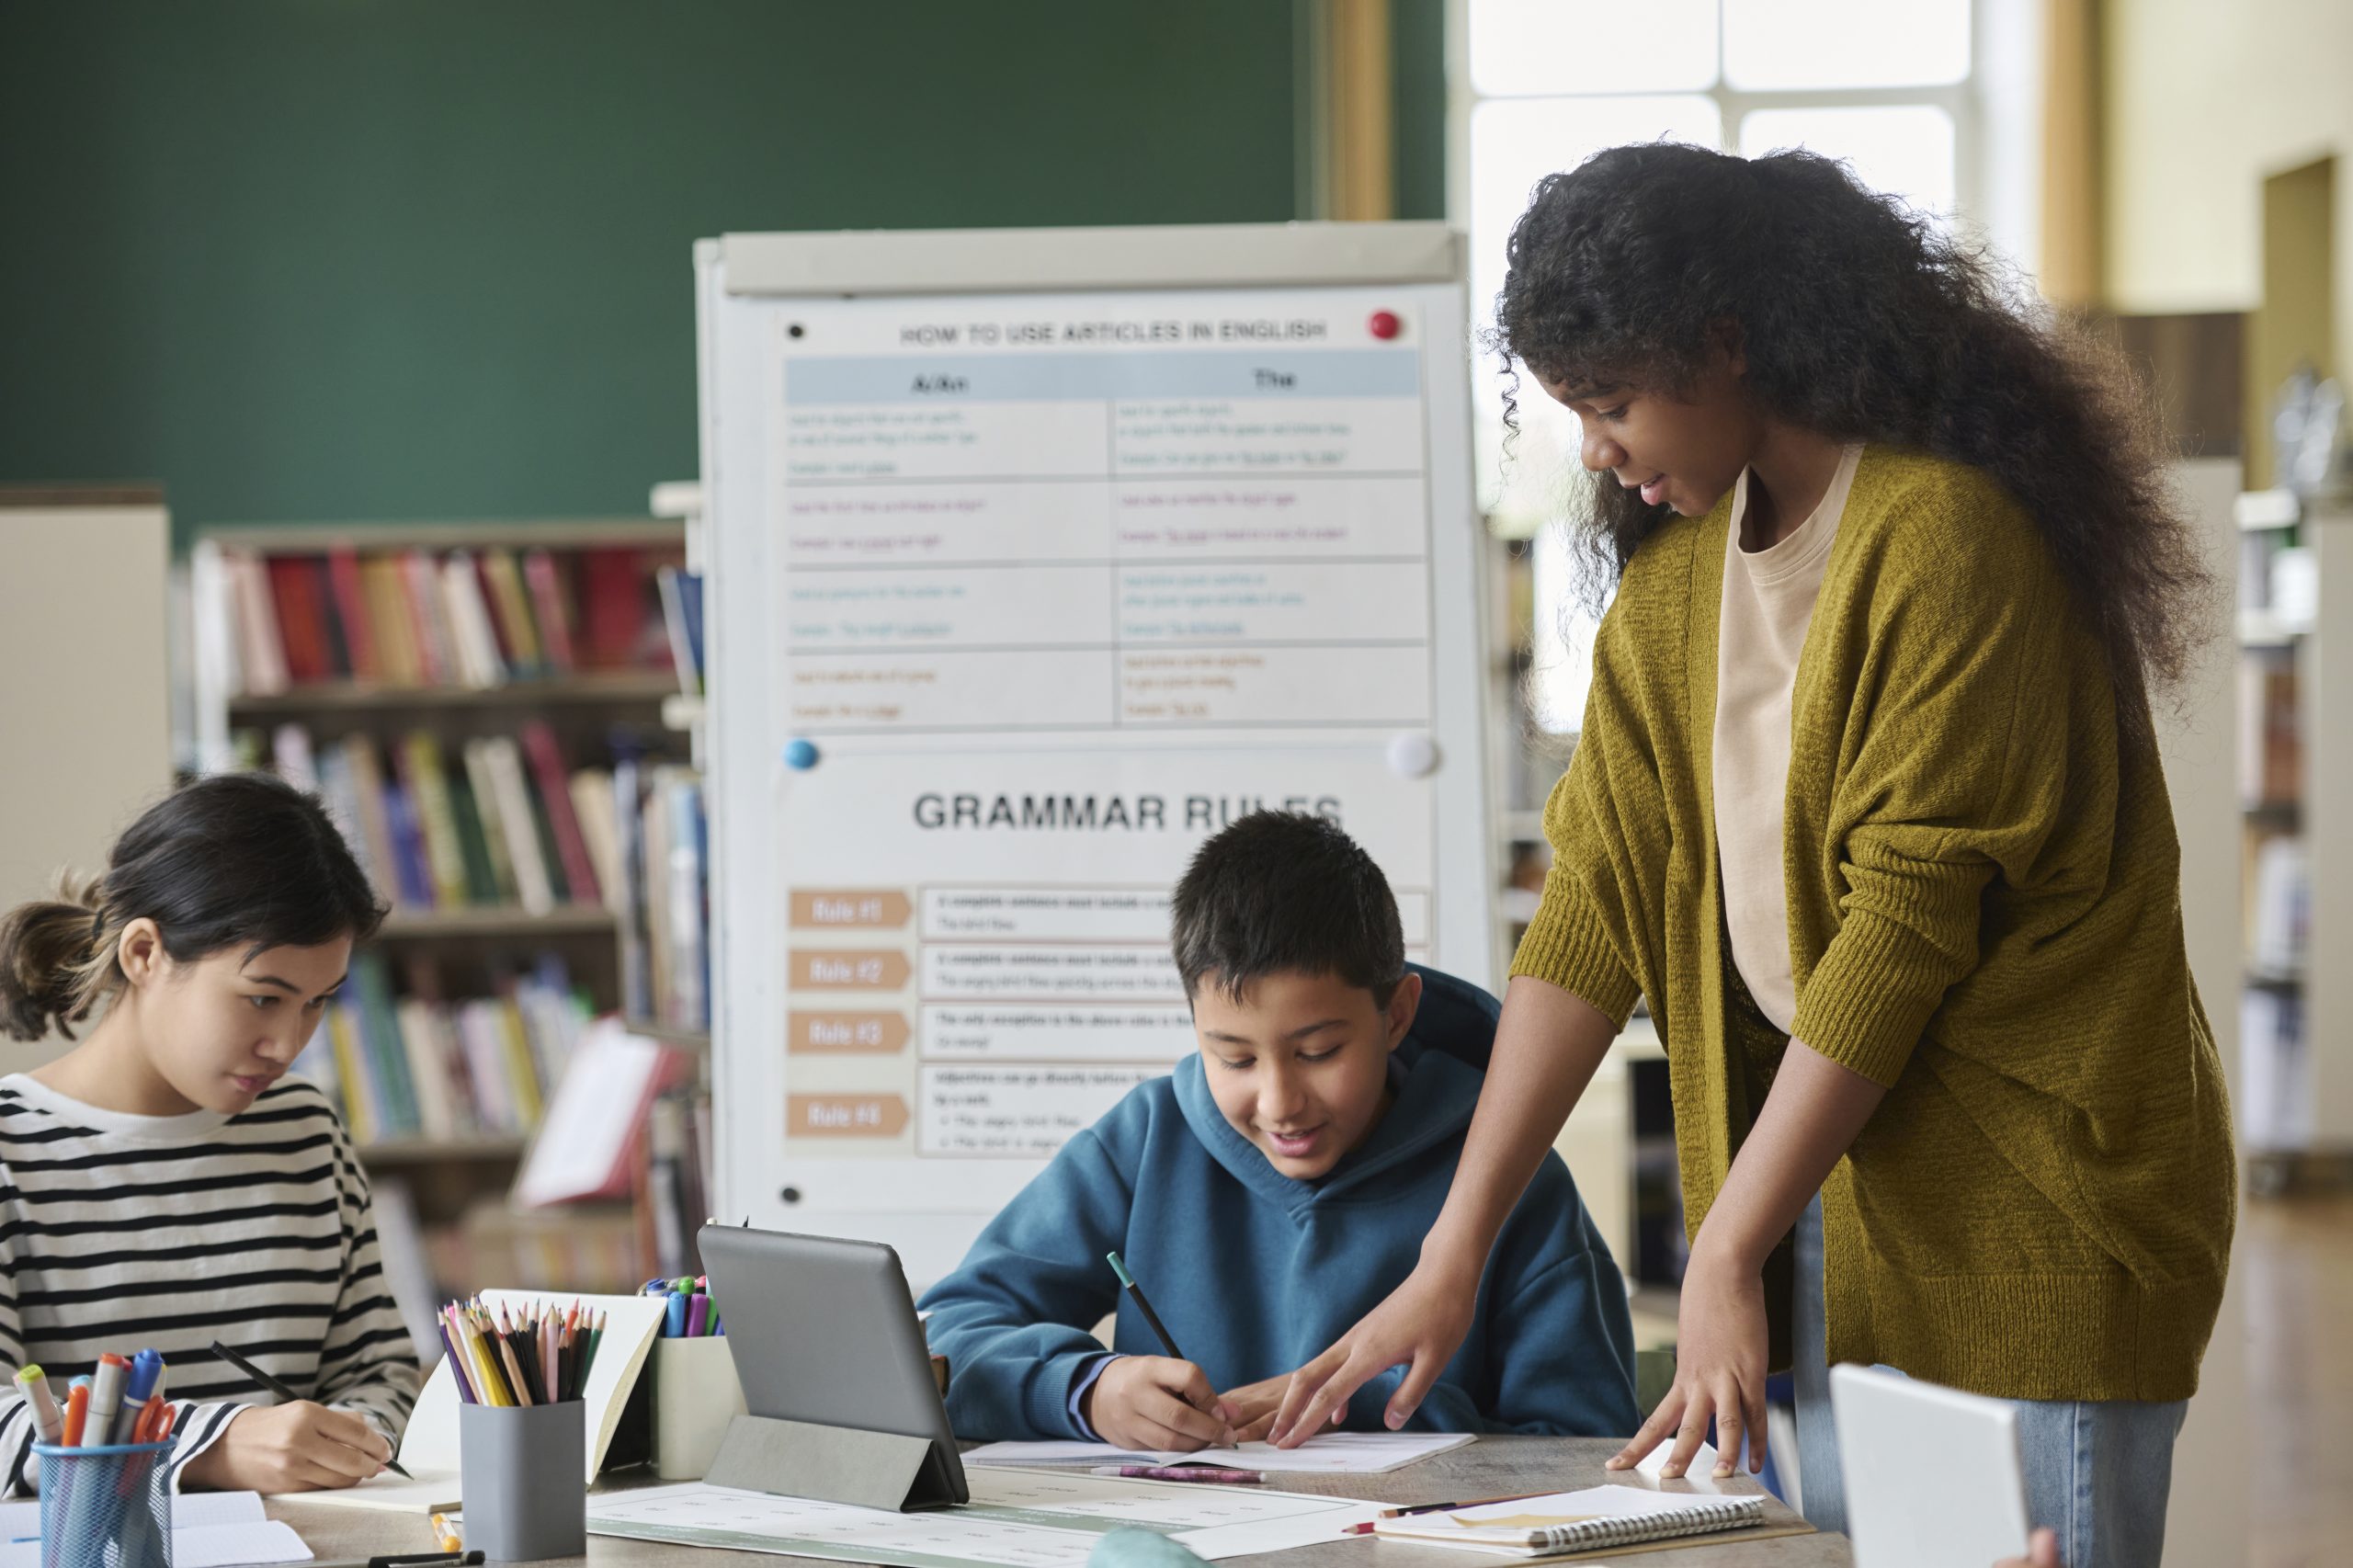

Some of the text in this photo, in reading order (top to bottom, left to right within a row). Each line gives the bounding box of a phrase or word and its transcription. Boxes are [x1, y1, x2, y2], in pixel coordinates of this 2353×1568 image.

[900, 320, 1326, 345] HOW TO USE ARTICLES IN ENGLISH
[1252, 369, 1297, 390] The
[915, 794, 1165, 830] GRAMMAR
[813, 898, 882, 922] Rule #1
[811, 959, 882, 982] Rule #2
[811, 1020, 851, 1043] Rule
[809, 1103, 851, 1126] Rule
